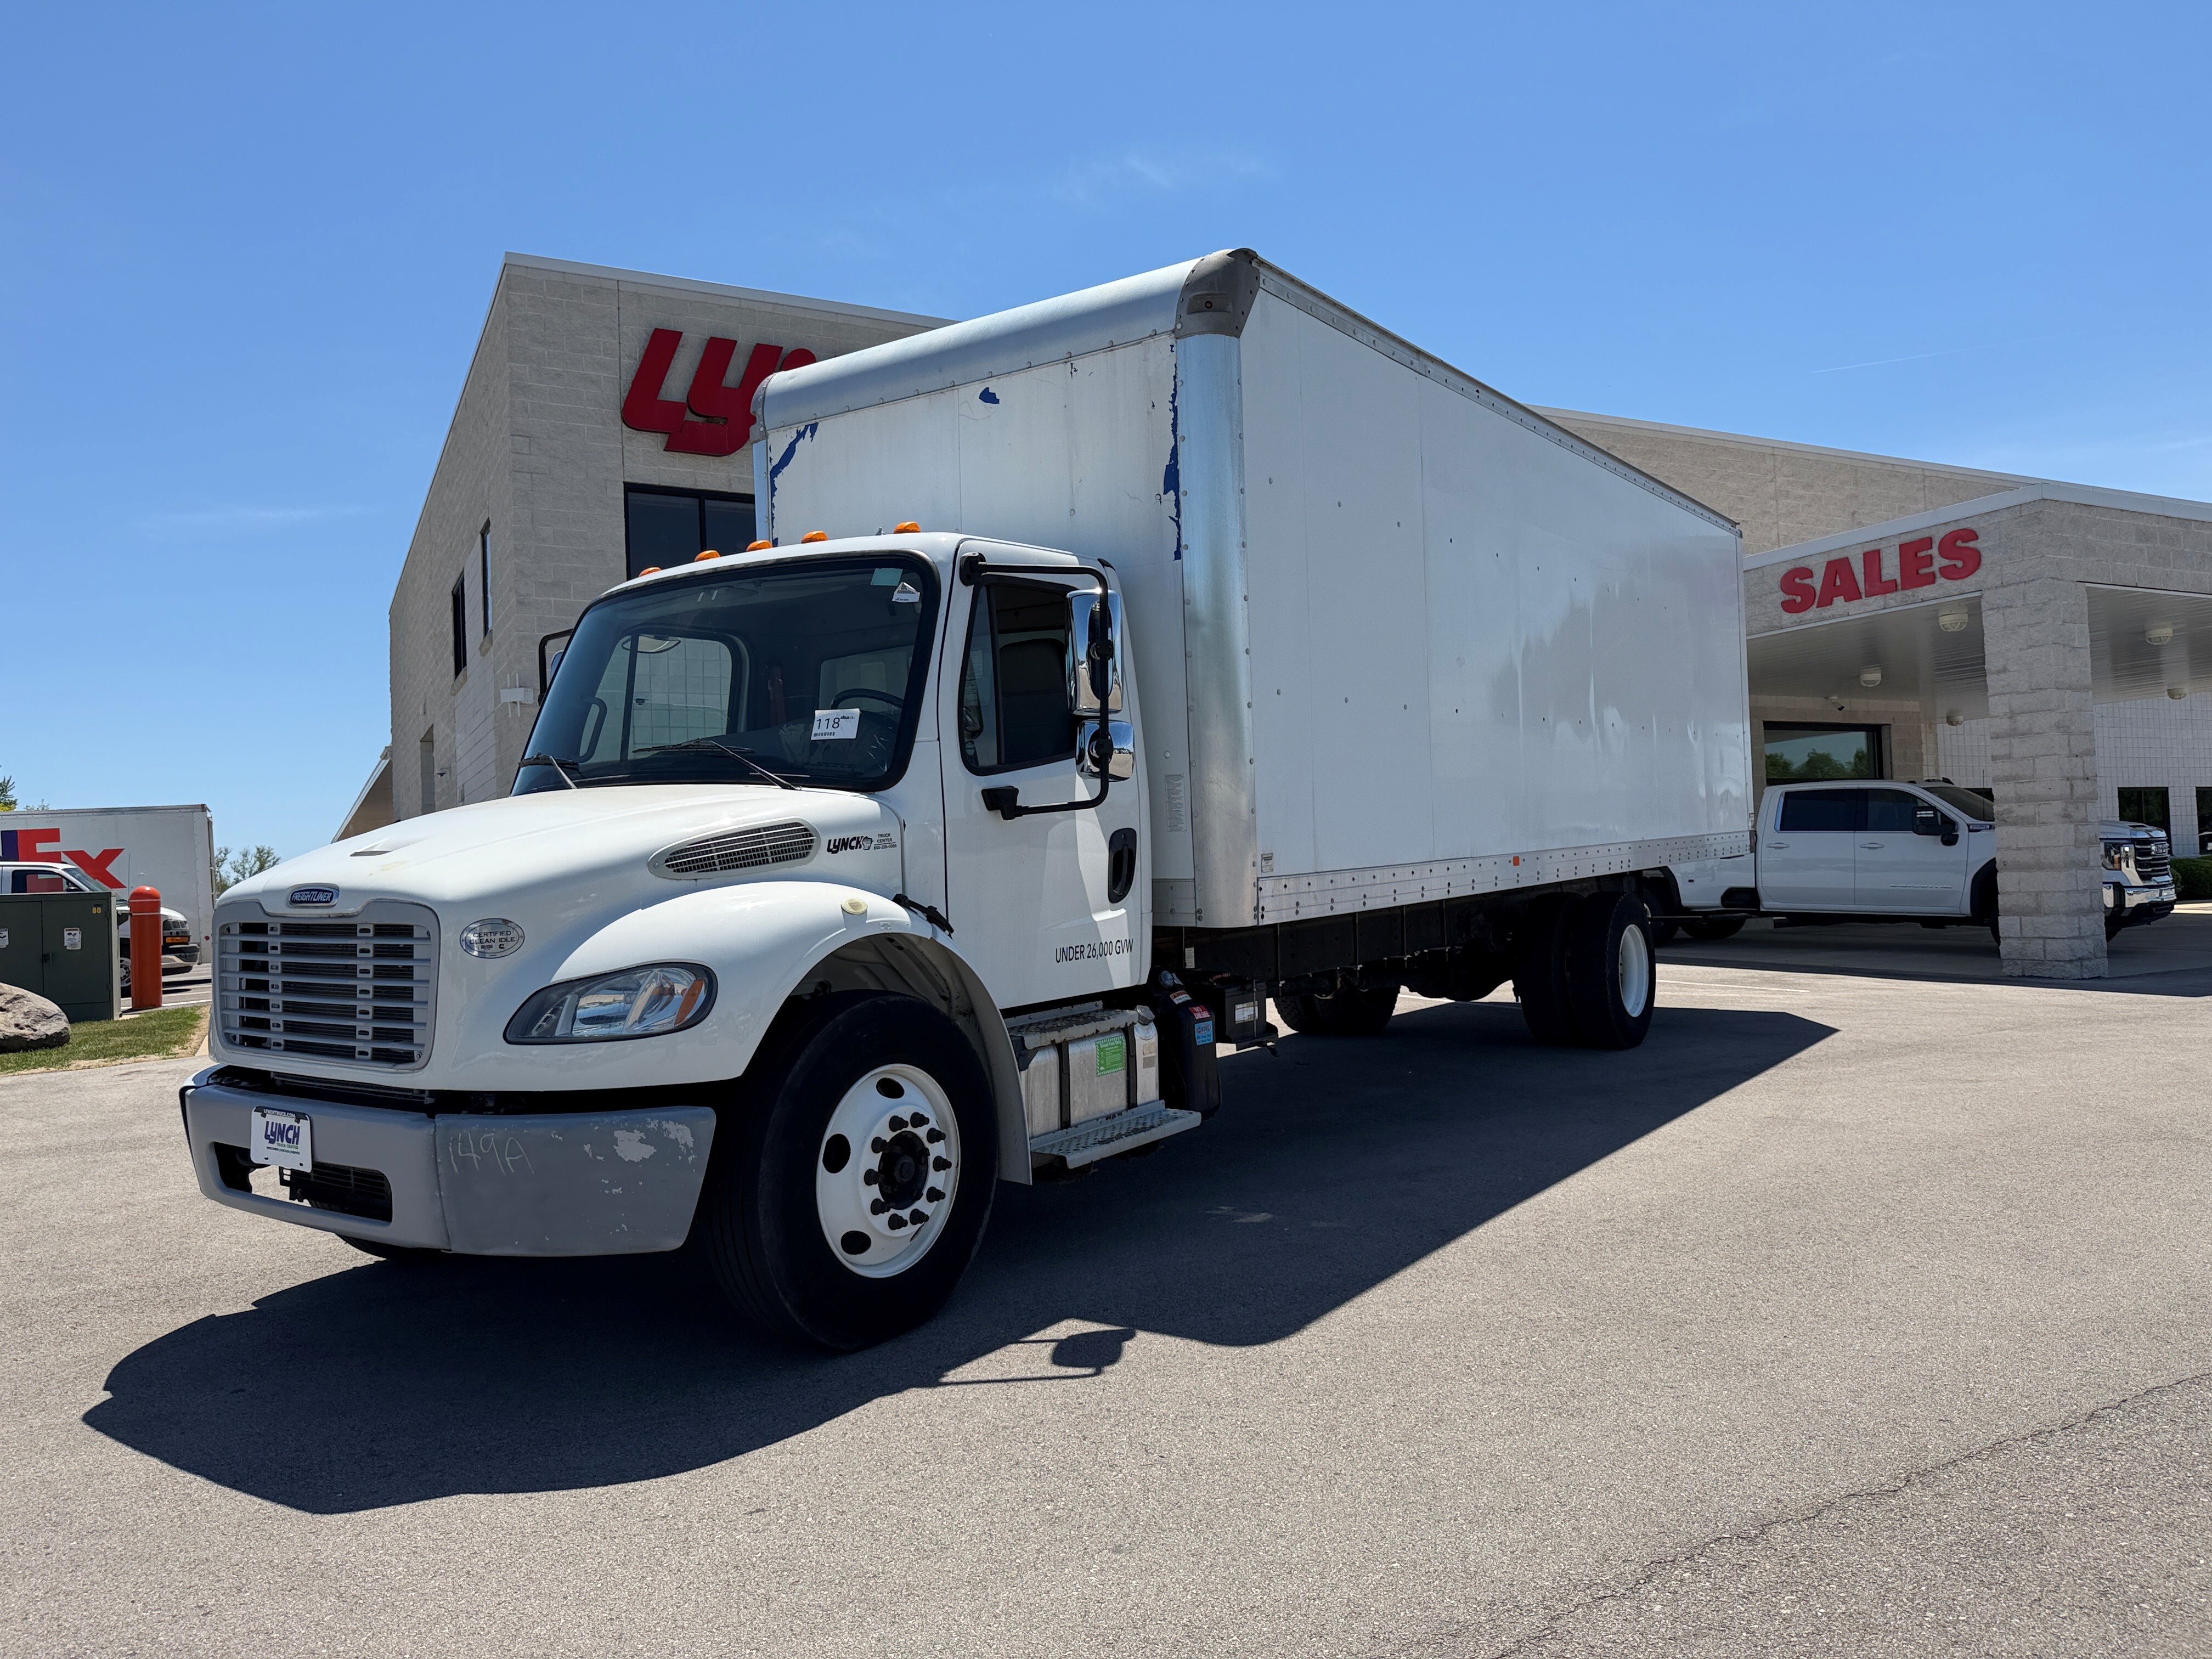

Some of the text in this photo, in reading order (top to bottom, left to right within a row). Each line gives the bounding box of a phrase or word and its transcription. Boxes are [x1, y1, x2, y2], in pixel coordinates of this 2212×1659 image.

[1780, 528, 1982, 614] SALES
[816, 718, 840, 730] 118
[827, 836, 864, 855] LYNCH
[291, 890, 332, 901] FREIGHTLINER
[1056, 938, 1134, 963] UNDER 26,000 GVW
[264, 1121, 301, 1146] LYNCH
